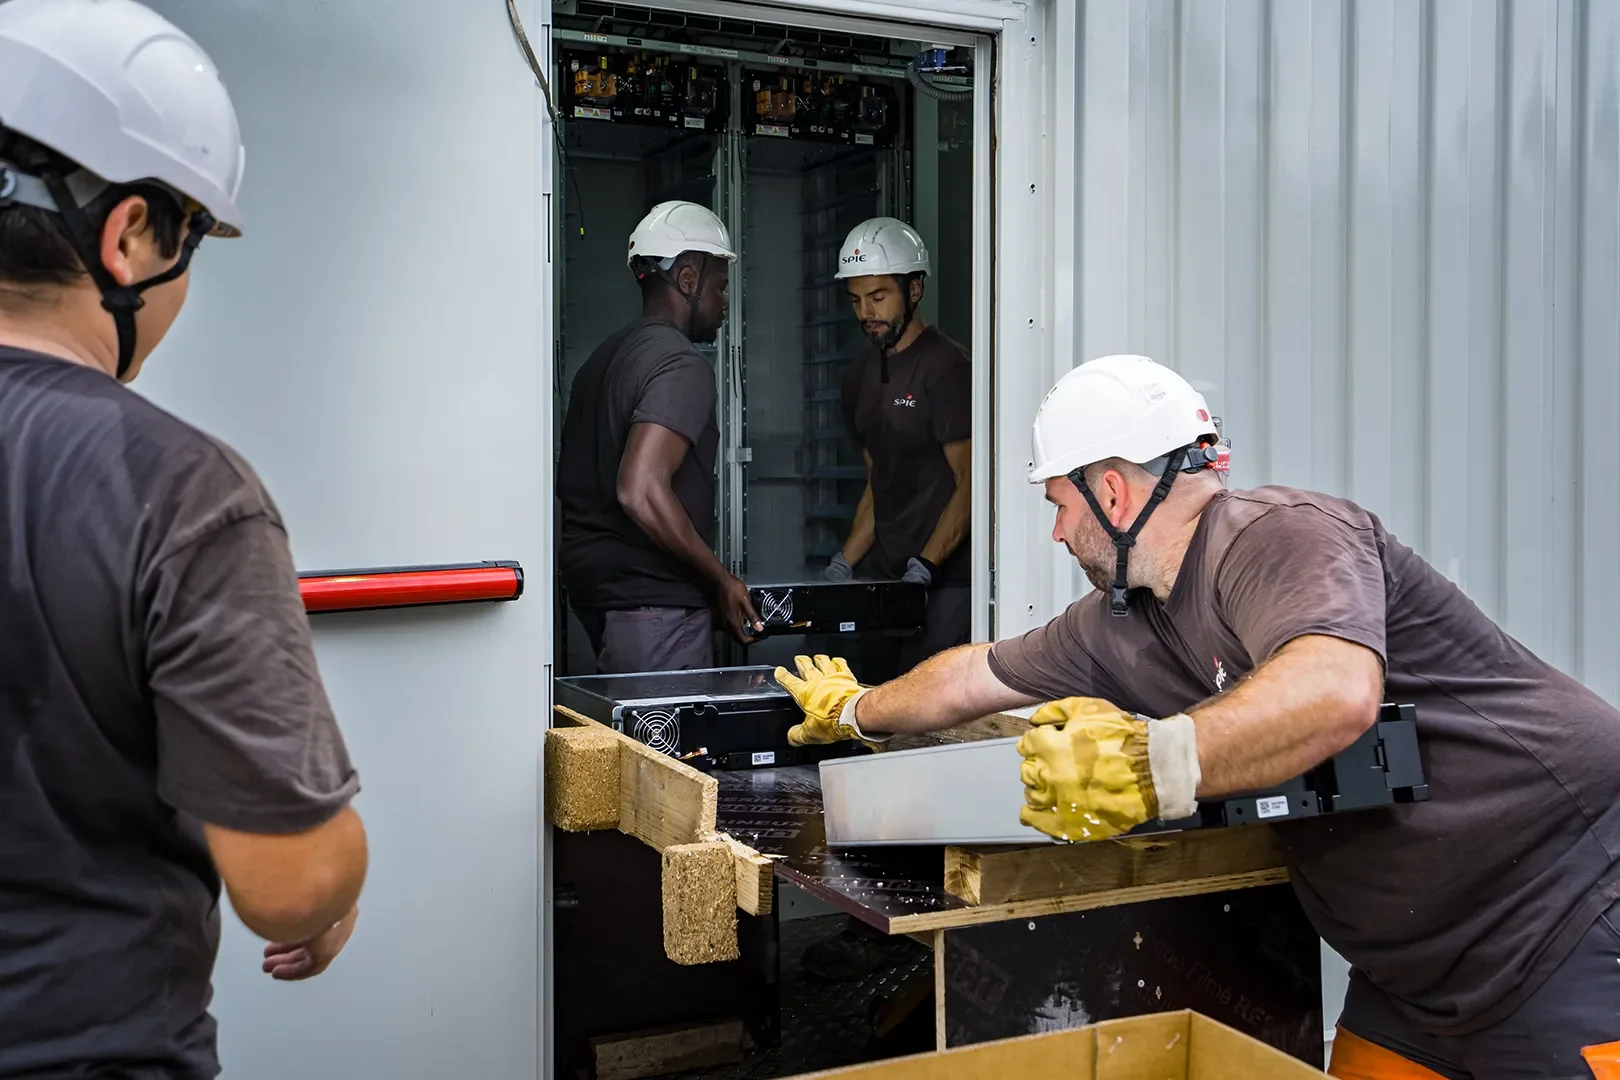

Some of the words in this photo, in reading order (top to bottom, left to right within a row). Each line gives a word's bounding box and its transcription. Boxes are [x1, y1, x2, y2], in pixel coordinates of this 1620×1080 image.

[842, 253, 867, 264] SPIE
[893, 397, 917, 407] SPIE
[1215, 661, 1227, 692] PIE
